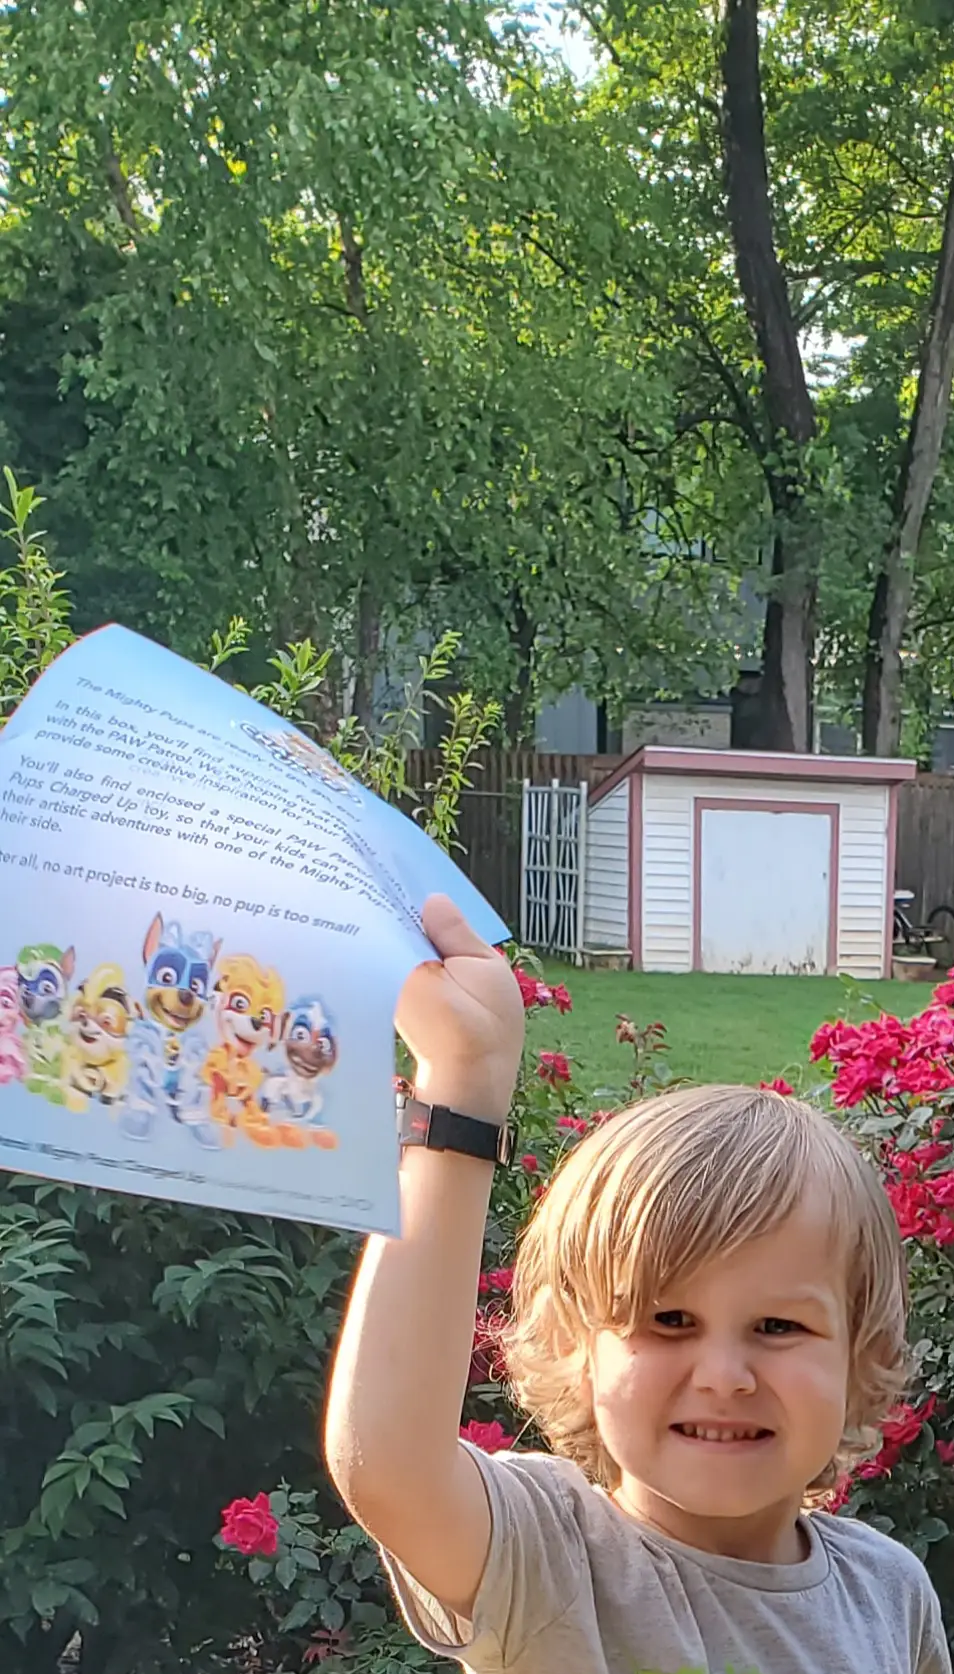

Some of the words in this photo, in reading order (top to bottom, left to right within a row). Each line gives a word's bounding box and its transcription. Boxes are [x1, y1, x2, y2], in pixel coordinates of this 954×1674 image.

[55, 700, 70, 711] In
[75, 706, 102, 721] this
[107, 715, 139, 734] box,
[146, 729, 190, 750] you'll
[193, 747, 224, 764] find
[76, 676, 102, 693] The
[105, 688, 158, 714] Mighty
[159, 711, 195, 731] Pups
[18, 754, 60, 774] You'll
[63, 767, 94, 783] also
[100, 775, 132, 793] find
[136, 786, 206, 812] enclosed
[209, 807, 220, 817] a
[226, 812, 281, 838] special
[286, 833, 326, 853] PAW
[34, 729, 92, 750] provide
[94, 743, 135, 761] some
[137, 756, 197, 782] creative
[199, 774, 279, 812] inspiration
[281, 806, 302, 821] for
[302, 817, 339, 838] your
[46, 714, 78, 730] with
[79, 722, 105, 736] the
[107, 730, 147, 749] PAW
[147, 742, 193, 766] Patrol.
[246, 779, 298, 811] hoping
[0, 807, 28, 826] heir
[30, 816, 62, 833] side.
[8, 770, 45, 791] Pups
[50, 780, 114, 805] Charged
[116, 795, 139, 813] Up
[144, 803, 170, 821] toy,
[175, 813, 195, 825] so
[199, 820, 231, 837] that
[233, 830, 270, 850] your
[275, 841, 309, 861] kids
[312, 857, 339, 873] can
[38, 798, 89, 819] artistic
[90, 809, 172, 838] adventures
[177, 829, 209, 846] with
[214, 839, 243, 855] one
[247, 849, 268, 862] of
[270, 855, 295, 871] the
[299, 864, 355, 892] Mighty
[43, 860, 60, 873] no
[64, 864, 84, 879] art
[85, 867, 138, 890] project
[139, 877, 151, 891] is
[154, 881, 179, 897] too
[181, 884, 209, 905] big,
[214, 894, 233, 908] no
[234, 899, 266, 918] pup
[267, 904, 281, 918] is
[283, 909, 310, 924] too
[312, 916, 361, 937] small!
